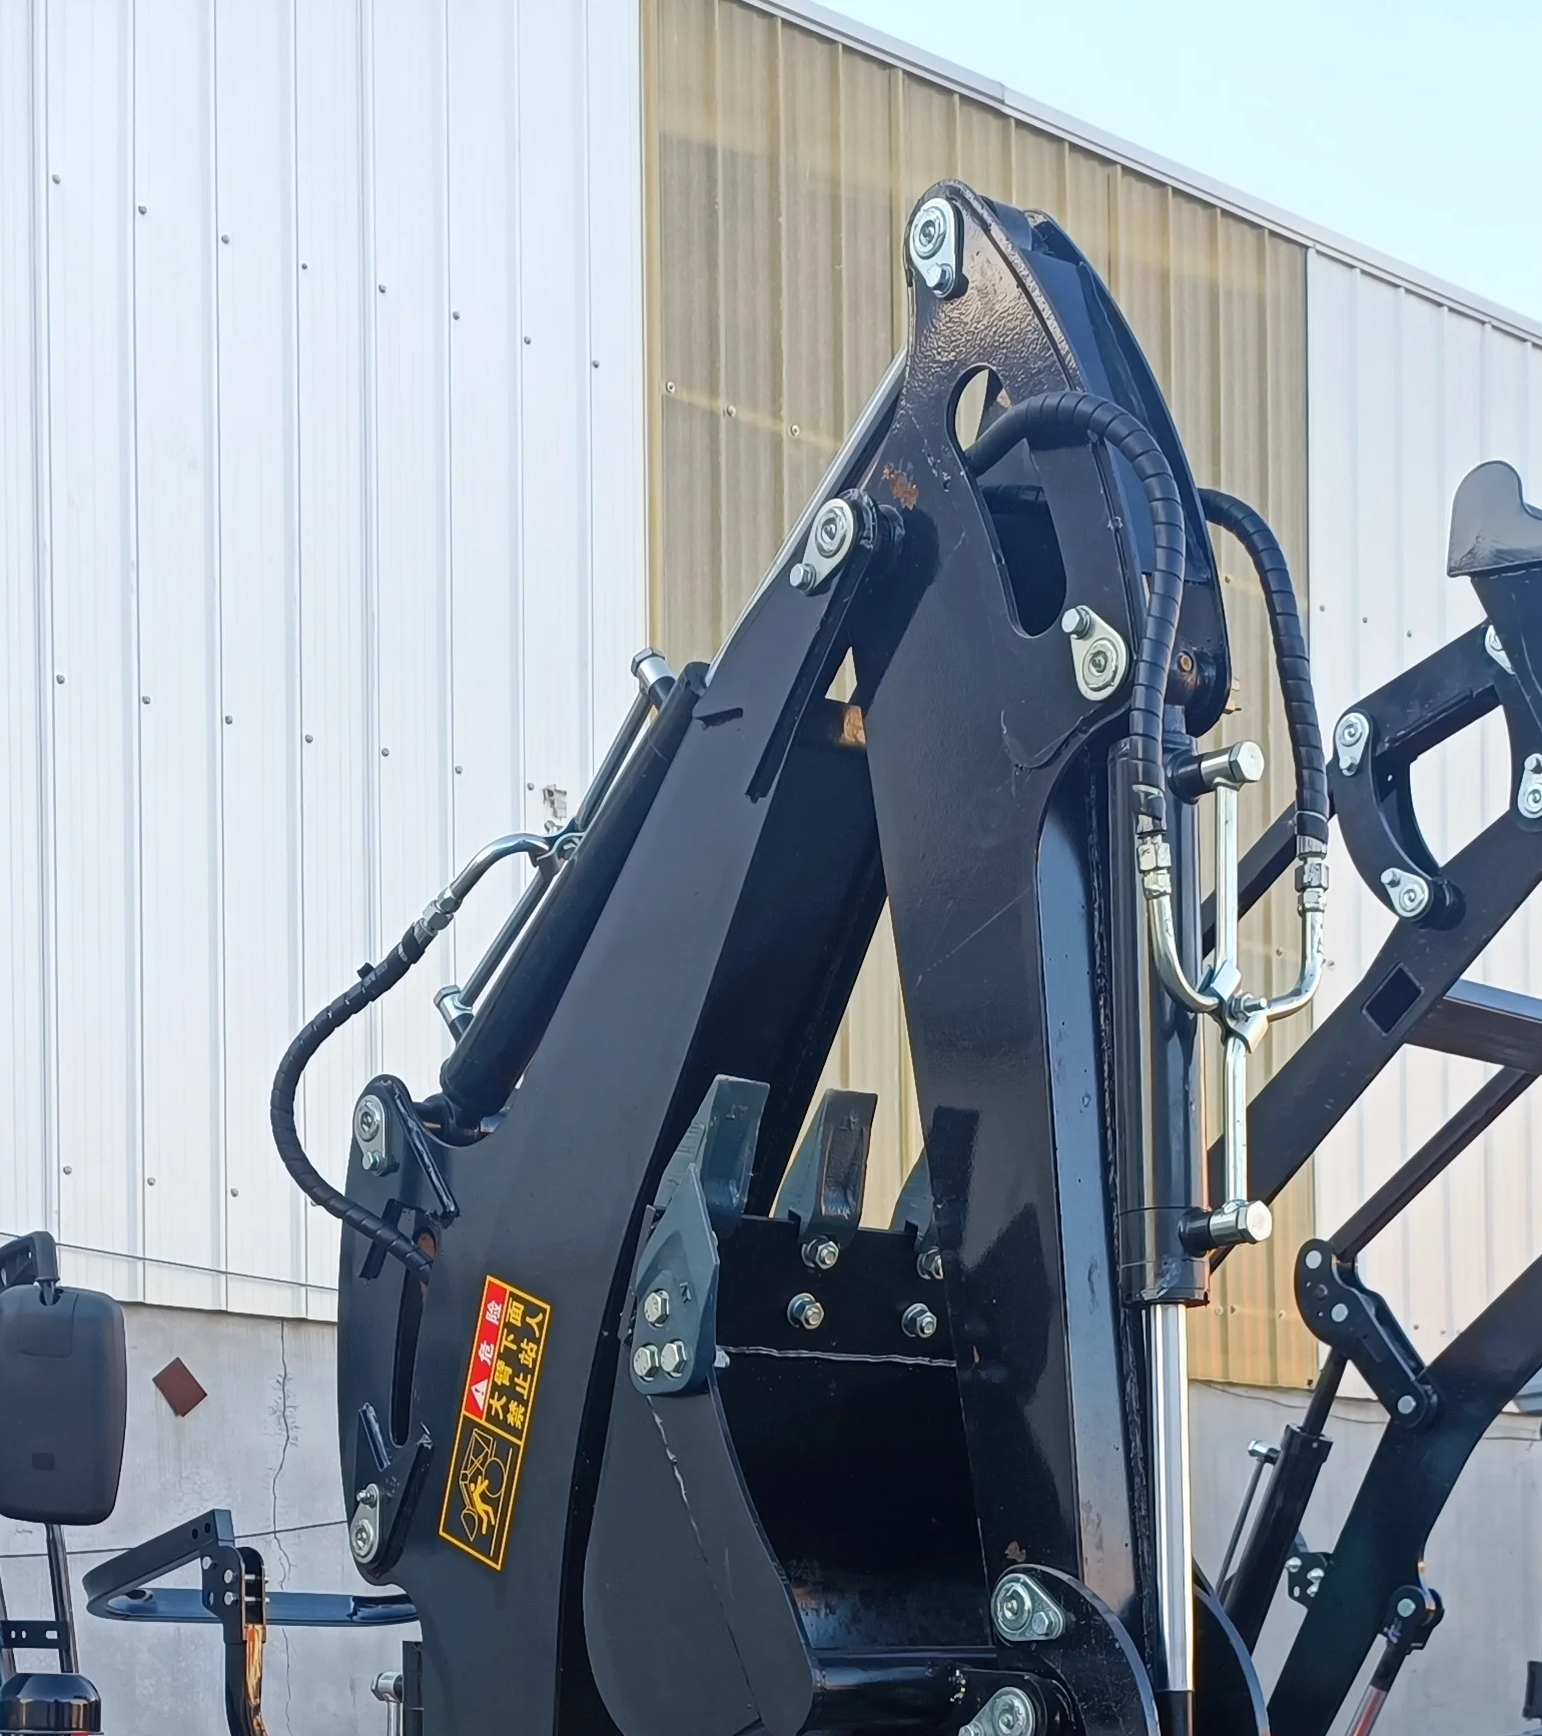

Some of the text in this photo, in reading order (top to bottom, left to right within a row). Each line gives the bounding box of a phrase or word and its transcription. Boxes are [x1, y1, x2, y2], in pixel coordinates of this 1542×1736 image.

[478, 1300, 503, 1365] 危险
[489, 1297, 526, 1421] 大臂下面
[506, 1311, 545, 1429] 禁止站人
